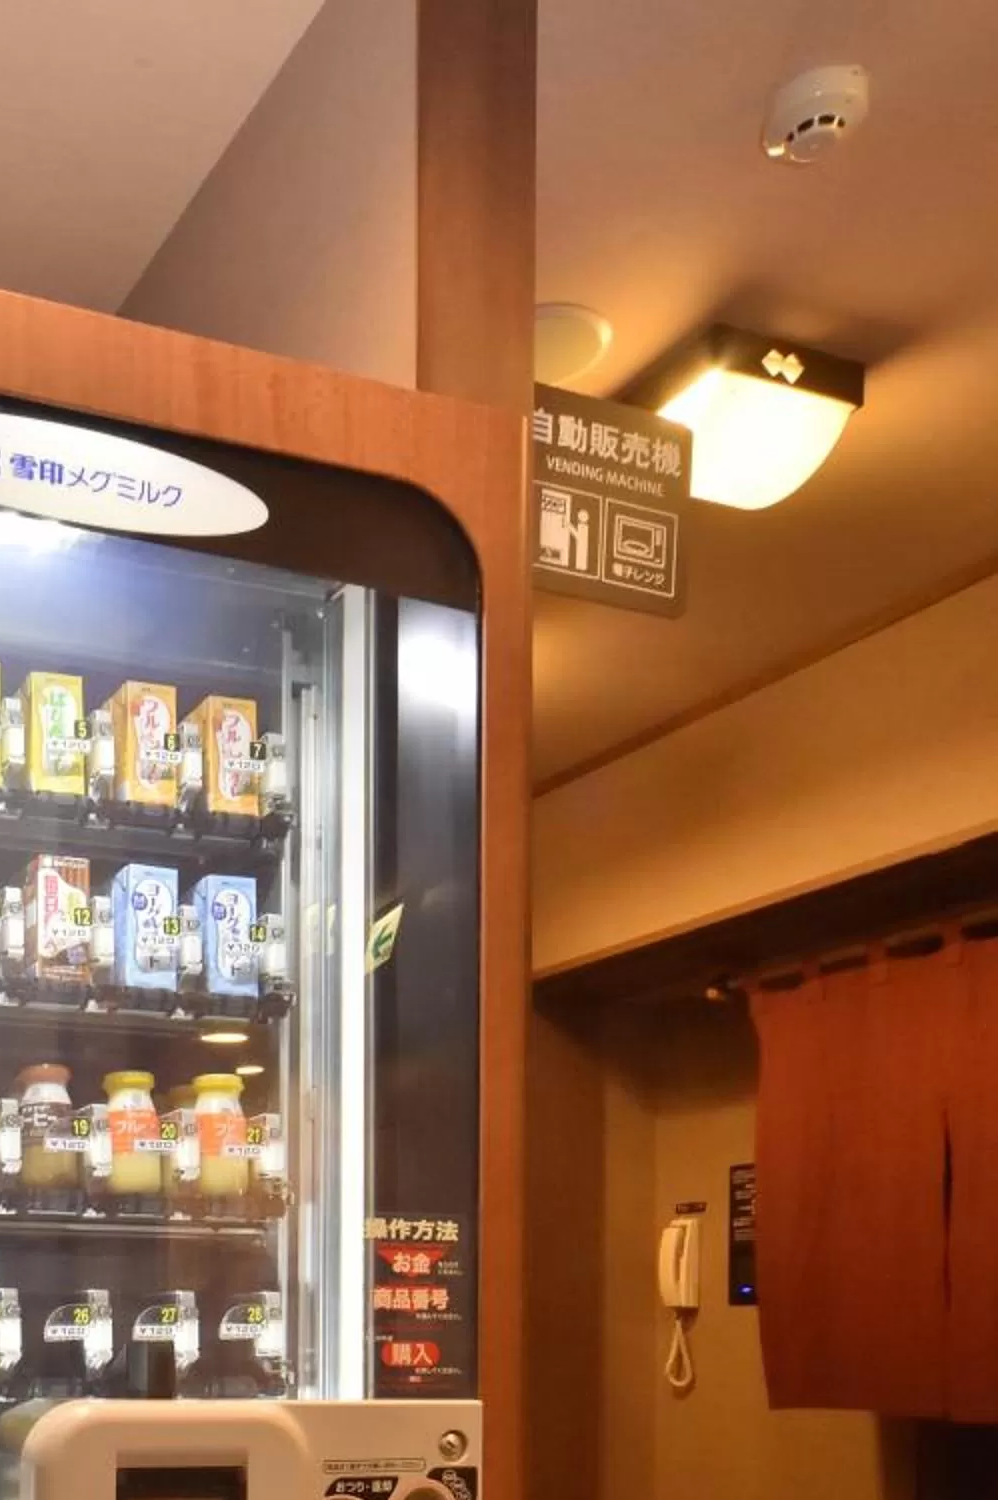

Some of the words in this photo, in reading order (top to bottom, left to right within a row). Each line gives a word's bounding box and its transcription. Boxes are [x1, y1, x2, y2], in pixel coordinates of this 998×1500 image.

[533, 407, 682, 477] 自動販売機
[9, 452, 182, 507] 雪印メグミルク
[546, 455, 604, 482] VENDING
[606, 470, 665, 497] MACHINE
[75, 908, 91, 925] 12
[73, 1118, 90, 1136] 19
[161, 1123, 177, 1140] 20
[247, 1127, 261, 1145] 21
[365, 1217, 459, 1242] 操作方法
[393, 1253, 431, 1274] お金
[373, 1287, 449, 1310] 商品番号
[73, 1306, 90, 1324] 26
[161, 1305, 177, 1323] 27
[391, 1343, 434, 1366] 購入
